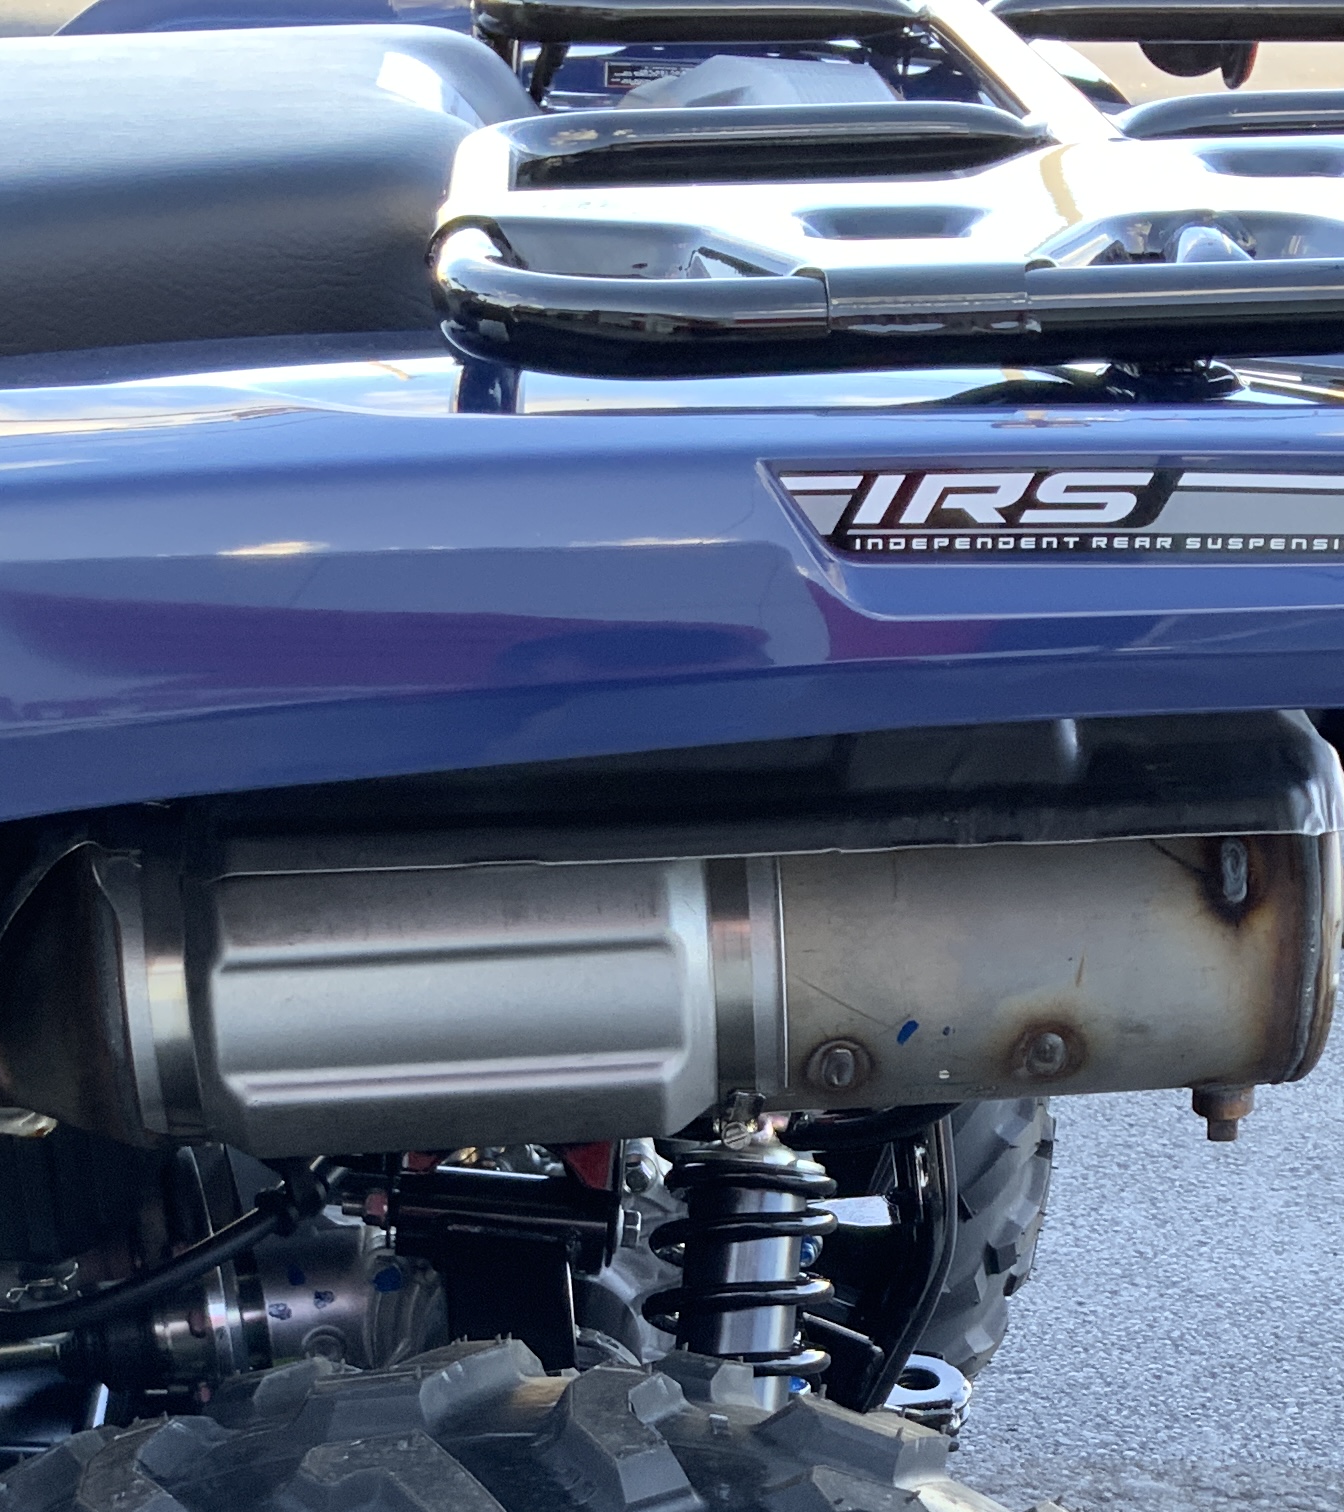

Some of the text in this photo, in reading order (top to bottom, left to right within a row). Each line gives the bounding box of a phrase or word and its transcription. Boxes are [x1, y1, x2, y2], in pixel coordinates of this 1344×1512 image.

[852, 471, 1155, 525] IRS
[855, 535, 1080, 551] INDEPENDENT
[1091, 535, 1173, 551] REAR
